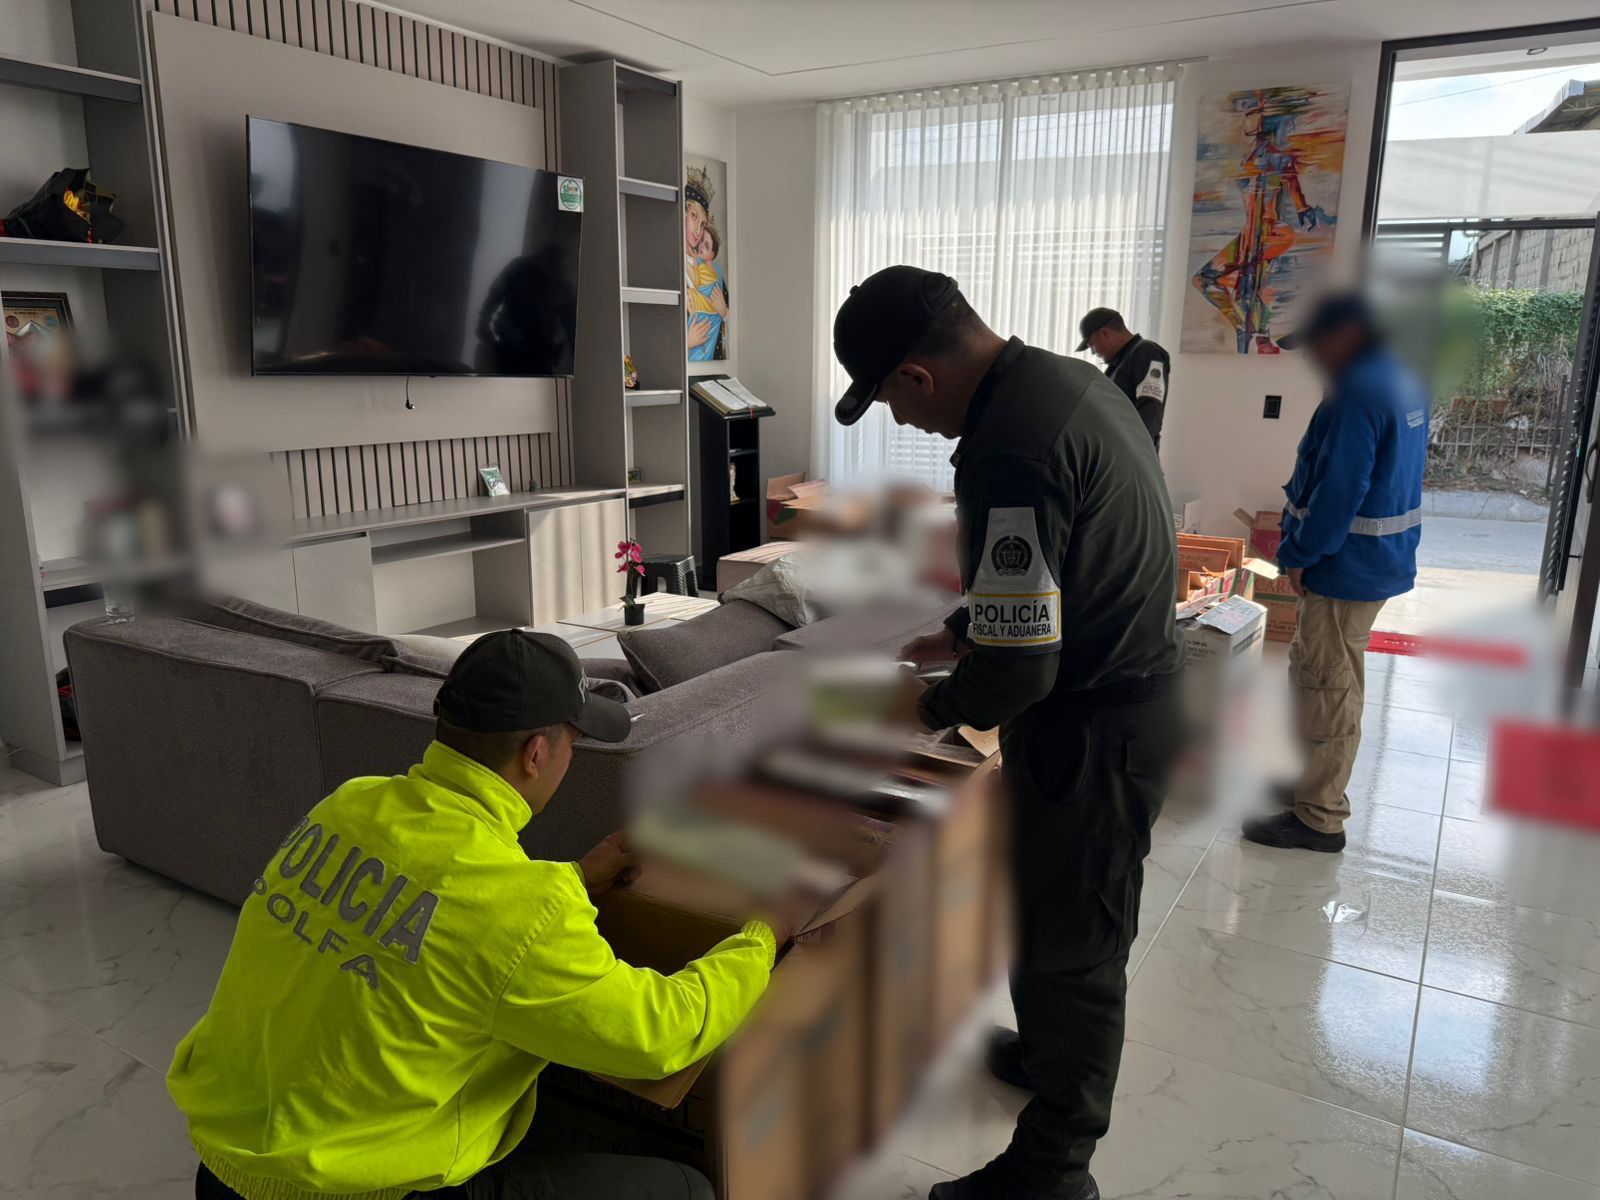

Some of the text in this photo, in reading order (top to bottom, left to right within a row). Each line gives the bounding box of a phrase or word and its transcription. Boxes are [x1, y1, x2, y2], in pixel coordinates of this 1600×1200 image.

[974, 600, 1050, 623] POLICÍA
[973, 623, 1051, 638] FISCAL Y ADUANERA
